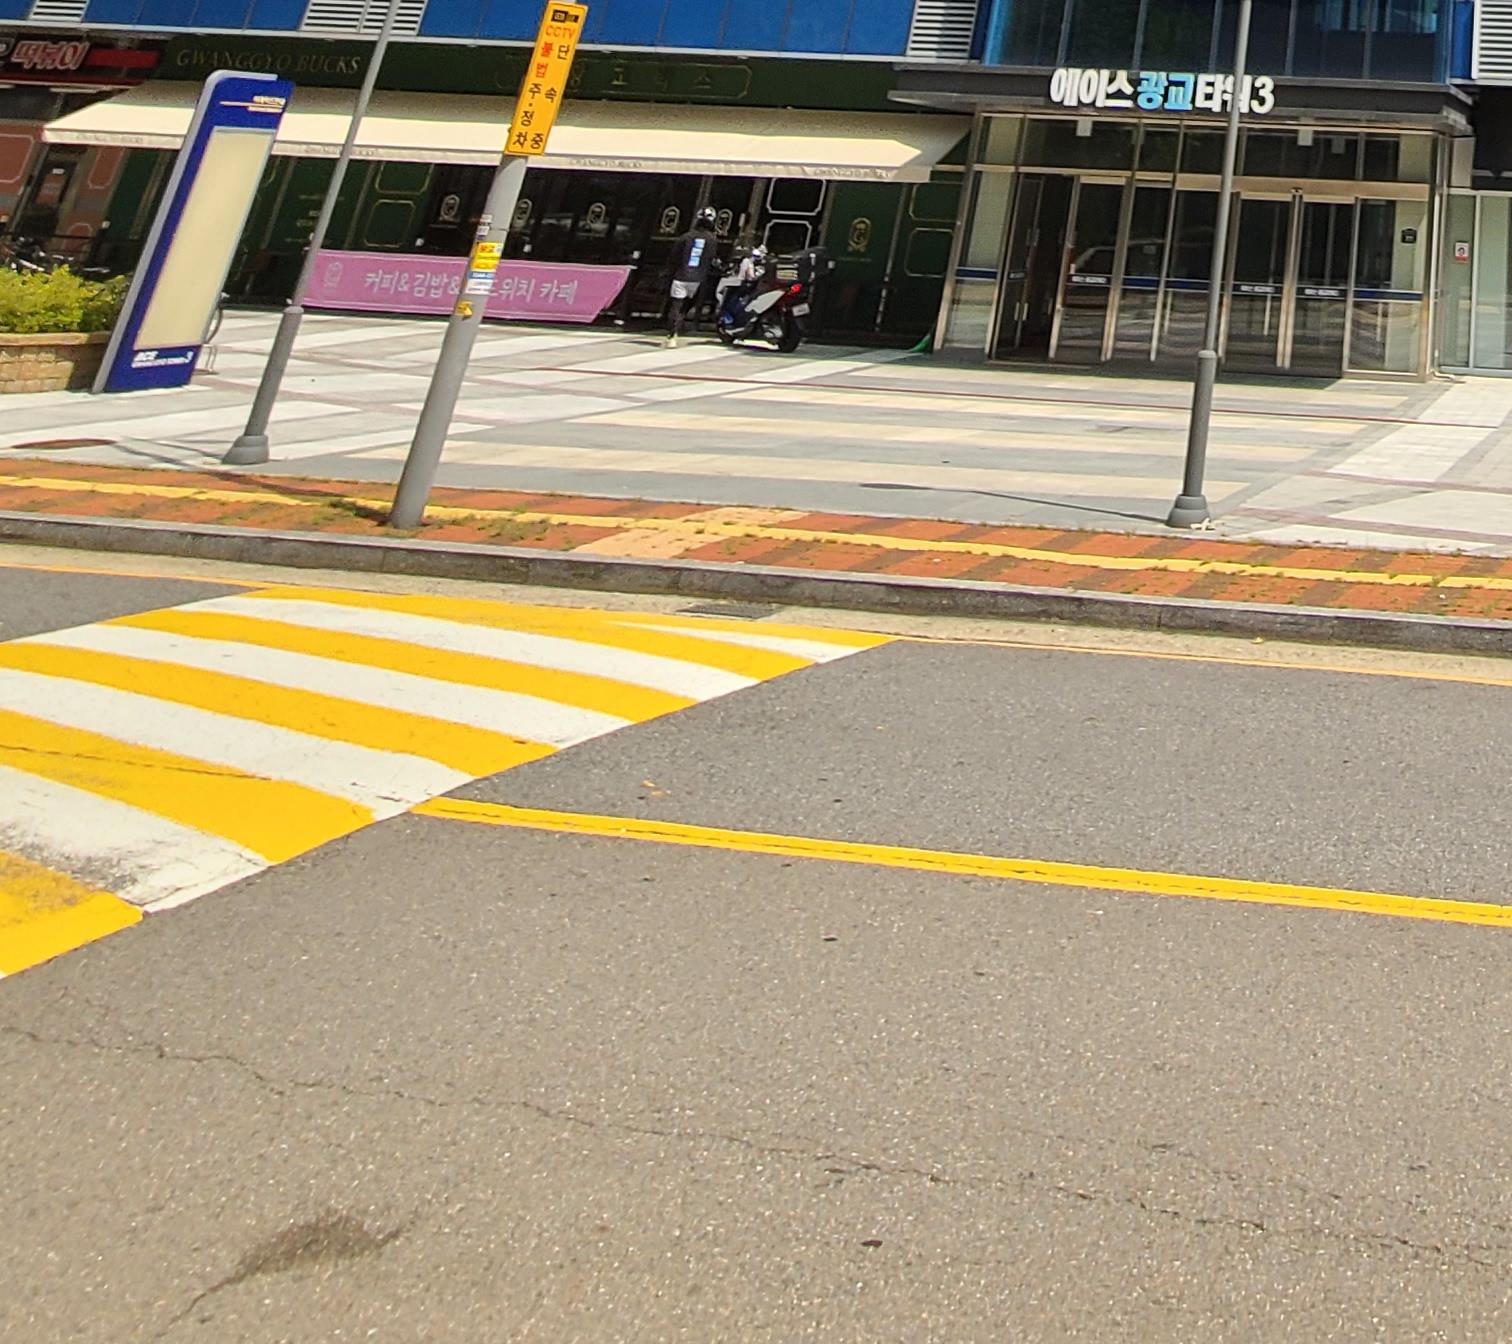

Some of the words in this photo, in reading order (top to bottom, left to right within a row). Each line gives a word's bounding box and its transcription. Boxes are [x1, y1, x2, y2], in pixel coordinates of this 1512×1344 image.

[545, 25, 576, 40] CCTV
[176, 49, 292, 72] GWANGGYO
[297, 55, 361, 74] BUCKS
[539, 280, 578, 305] 카페
